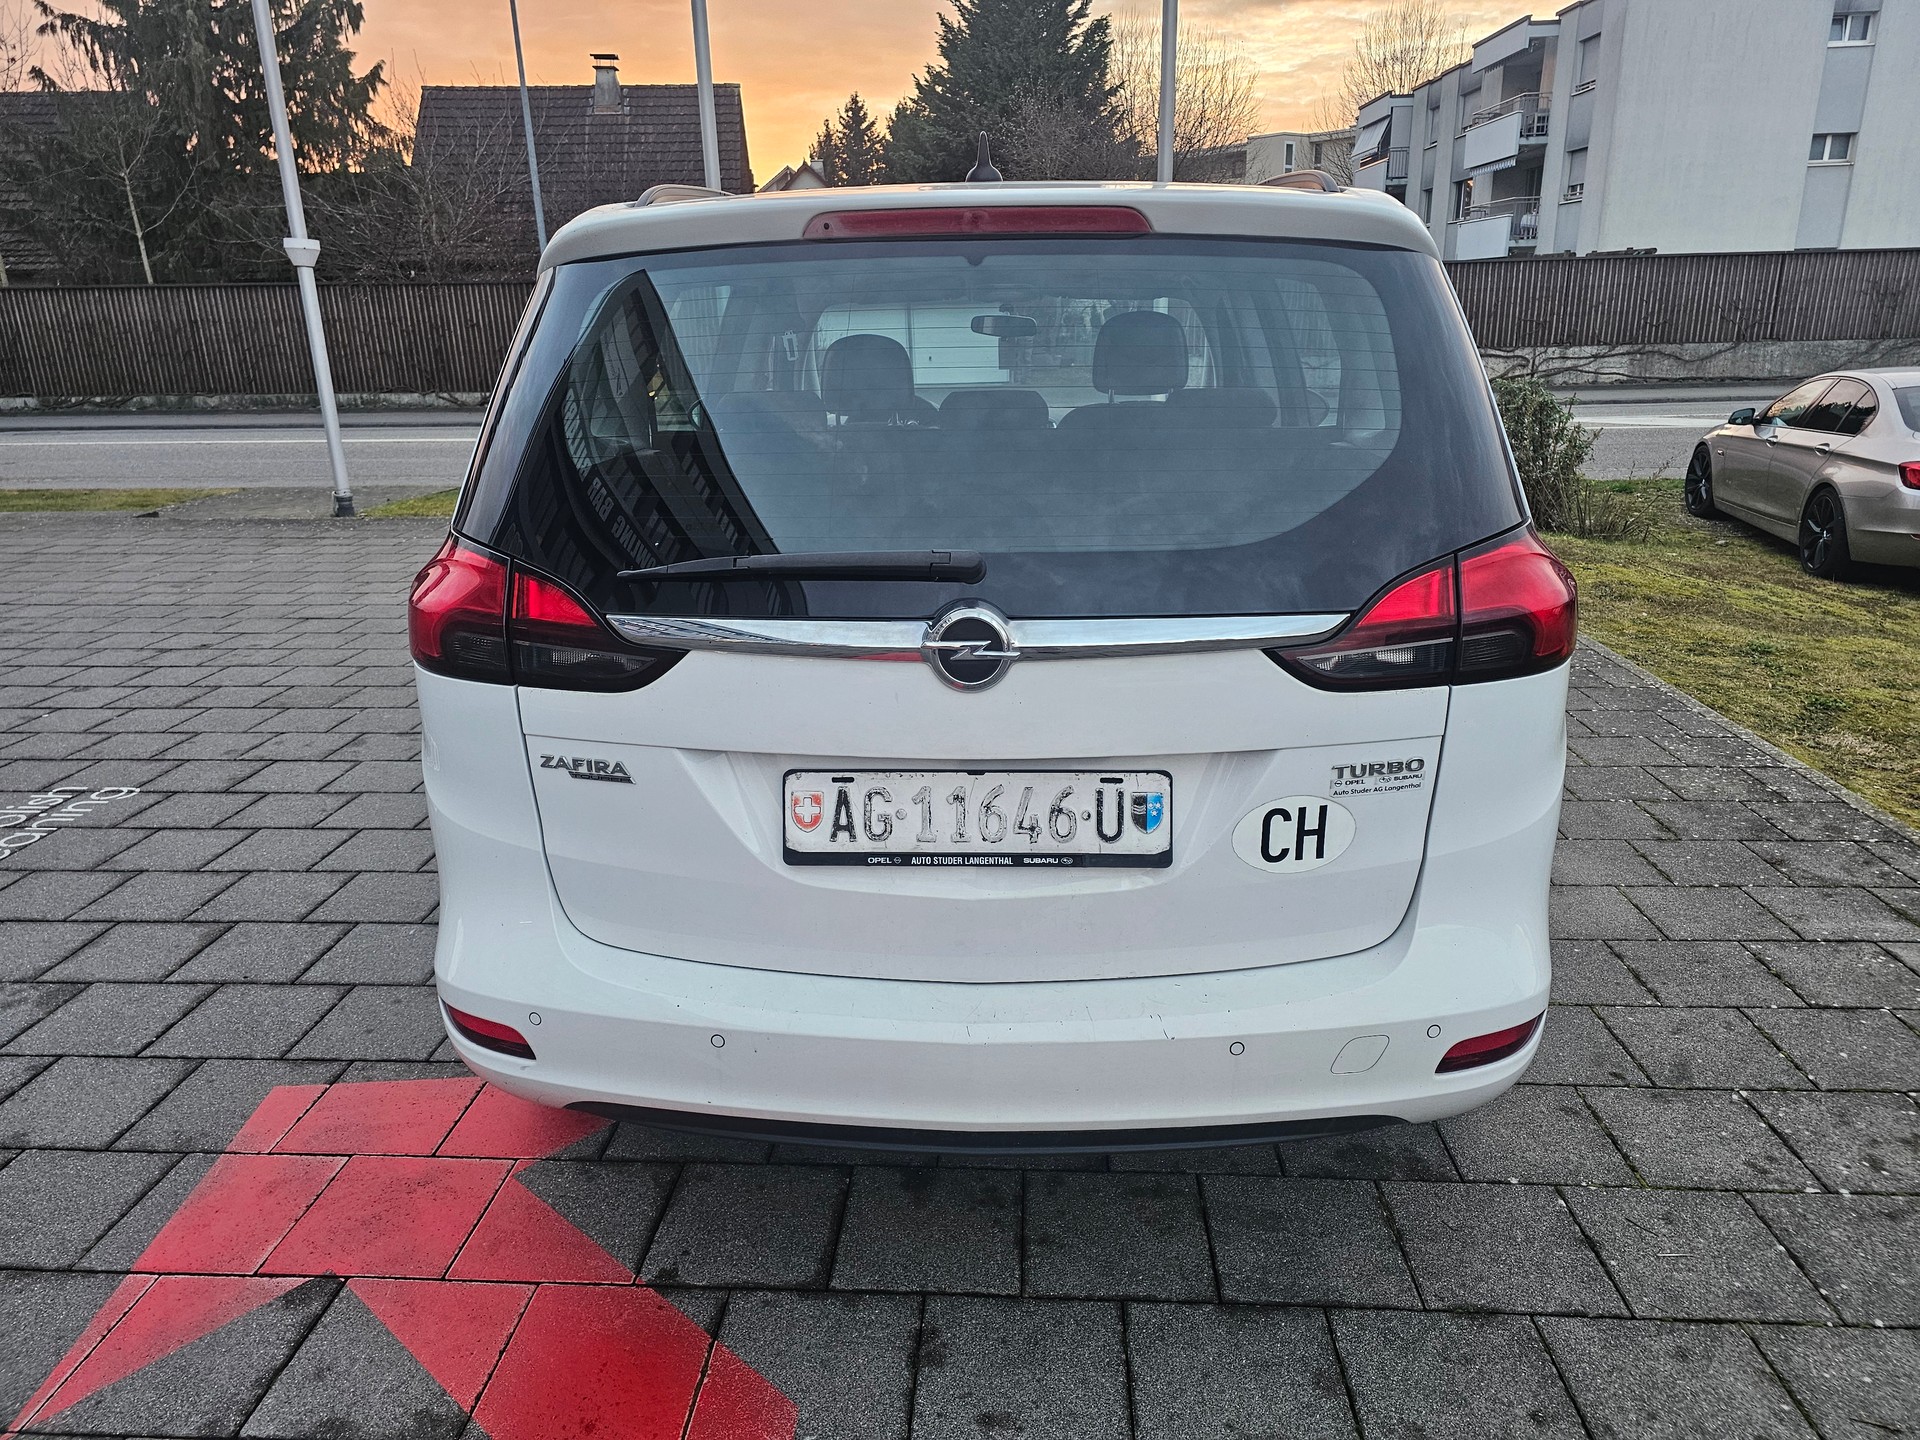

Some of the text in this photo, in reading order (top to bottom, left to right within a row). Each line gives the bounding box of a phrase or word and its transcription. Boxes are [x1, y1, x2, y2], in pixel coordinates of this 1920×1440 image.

[540, 754, 632, 777] ZAFIRA
[1331, 757, 1425, 780] TURBO
[1393, 774, 1423, 782] SUBARU
[1350, 787, 1372, 795] Studer
[1384, 782, 1422, 792] Langenthal
[1261, 804, 1329, 864] CH
[911, 856, 932, 865] AUTO
[933, 856, 963, 865] STUDER
[964, 856, 1014, 865] LANGENTHAL
